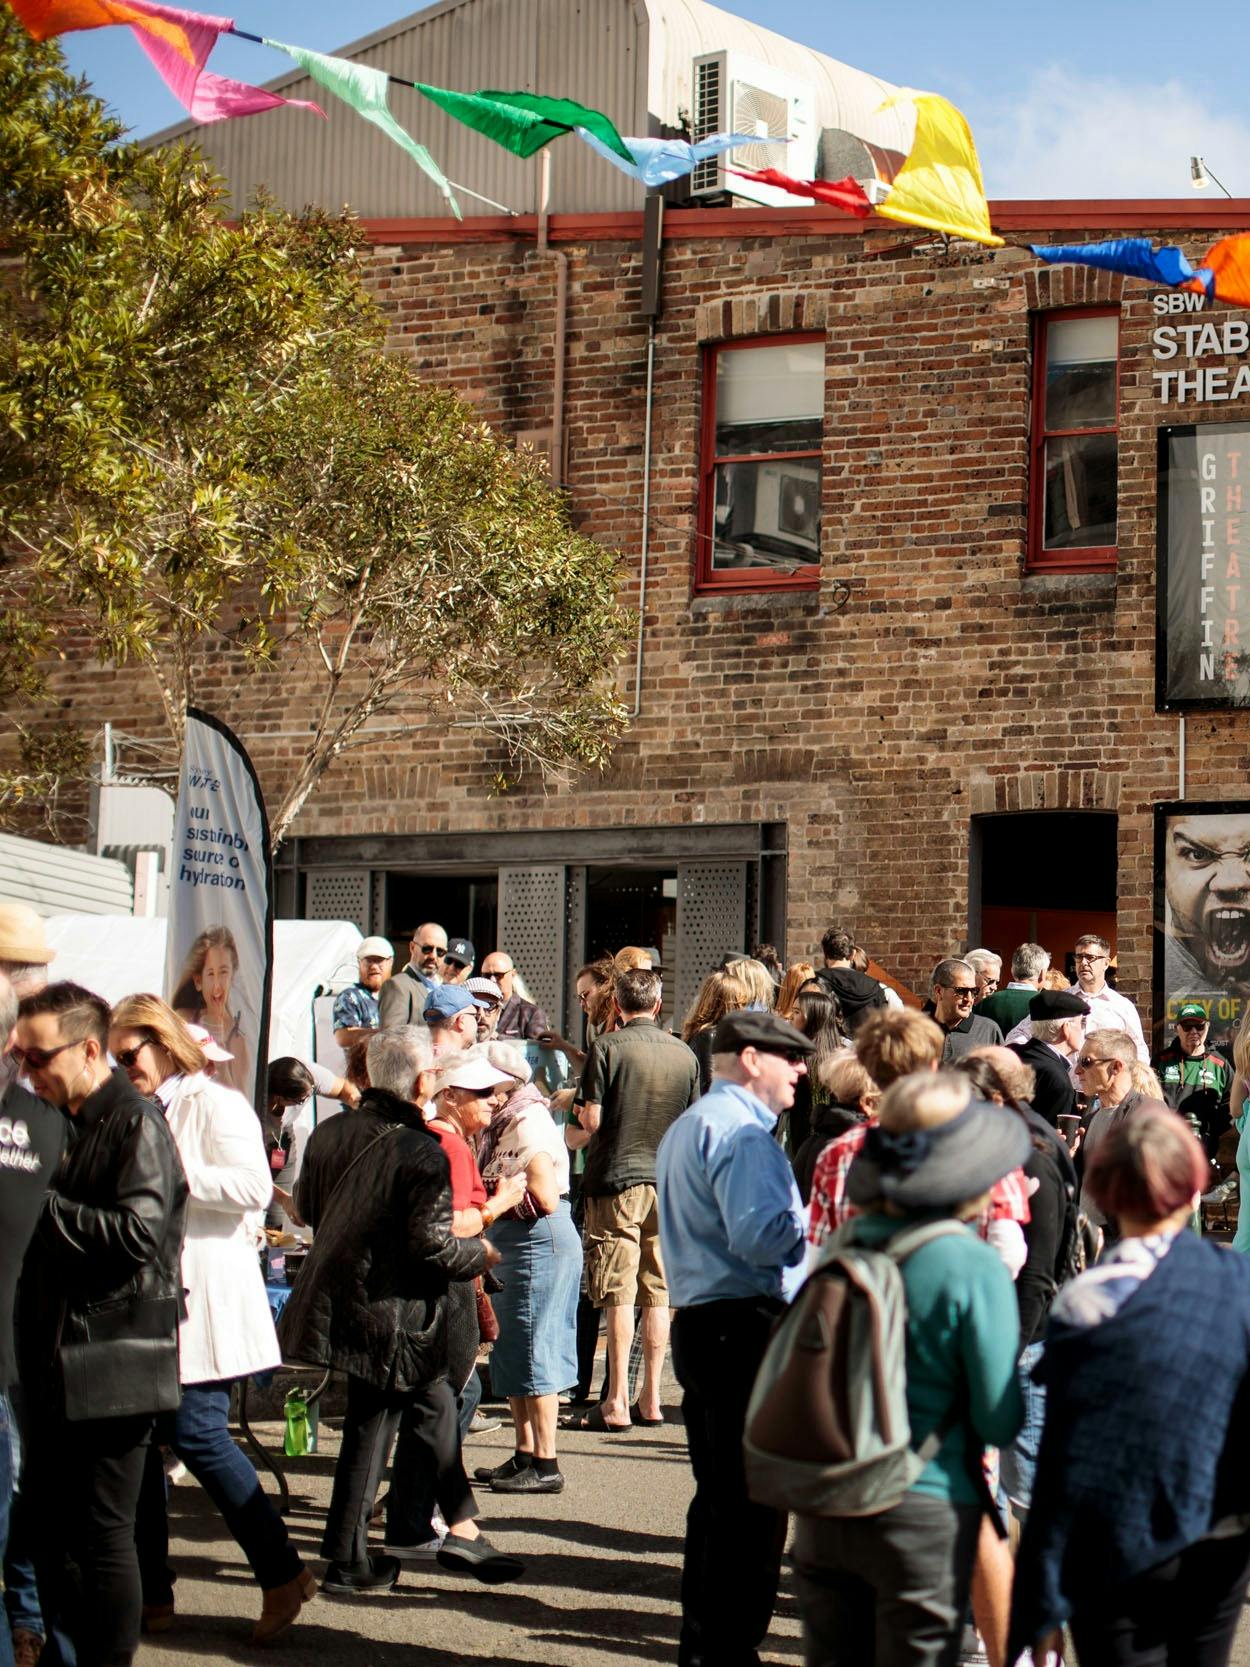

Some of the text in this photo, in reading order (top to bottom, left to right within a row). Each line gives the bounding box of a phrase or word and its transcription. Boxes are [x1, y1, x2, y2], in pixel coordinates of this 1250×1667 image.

[1153, 292, 1205, 315] SBW
[1200, 453, 1216, 681] GRIFFIN
[1224, 452, 1243, 680] THEATRE
[1167, 999, 1241, 1020] CY OF
